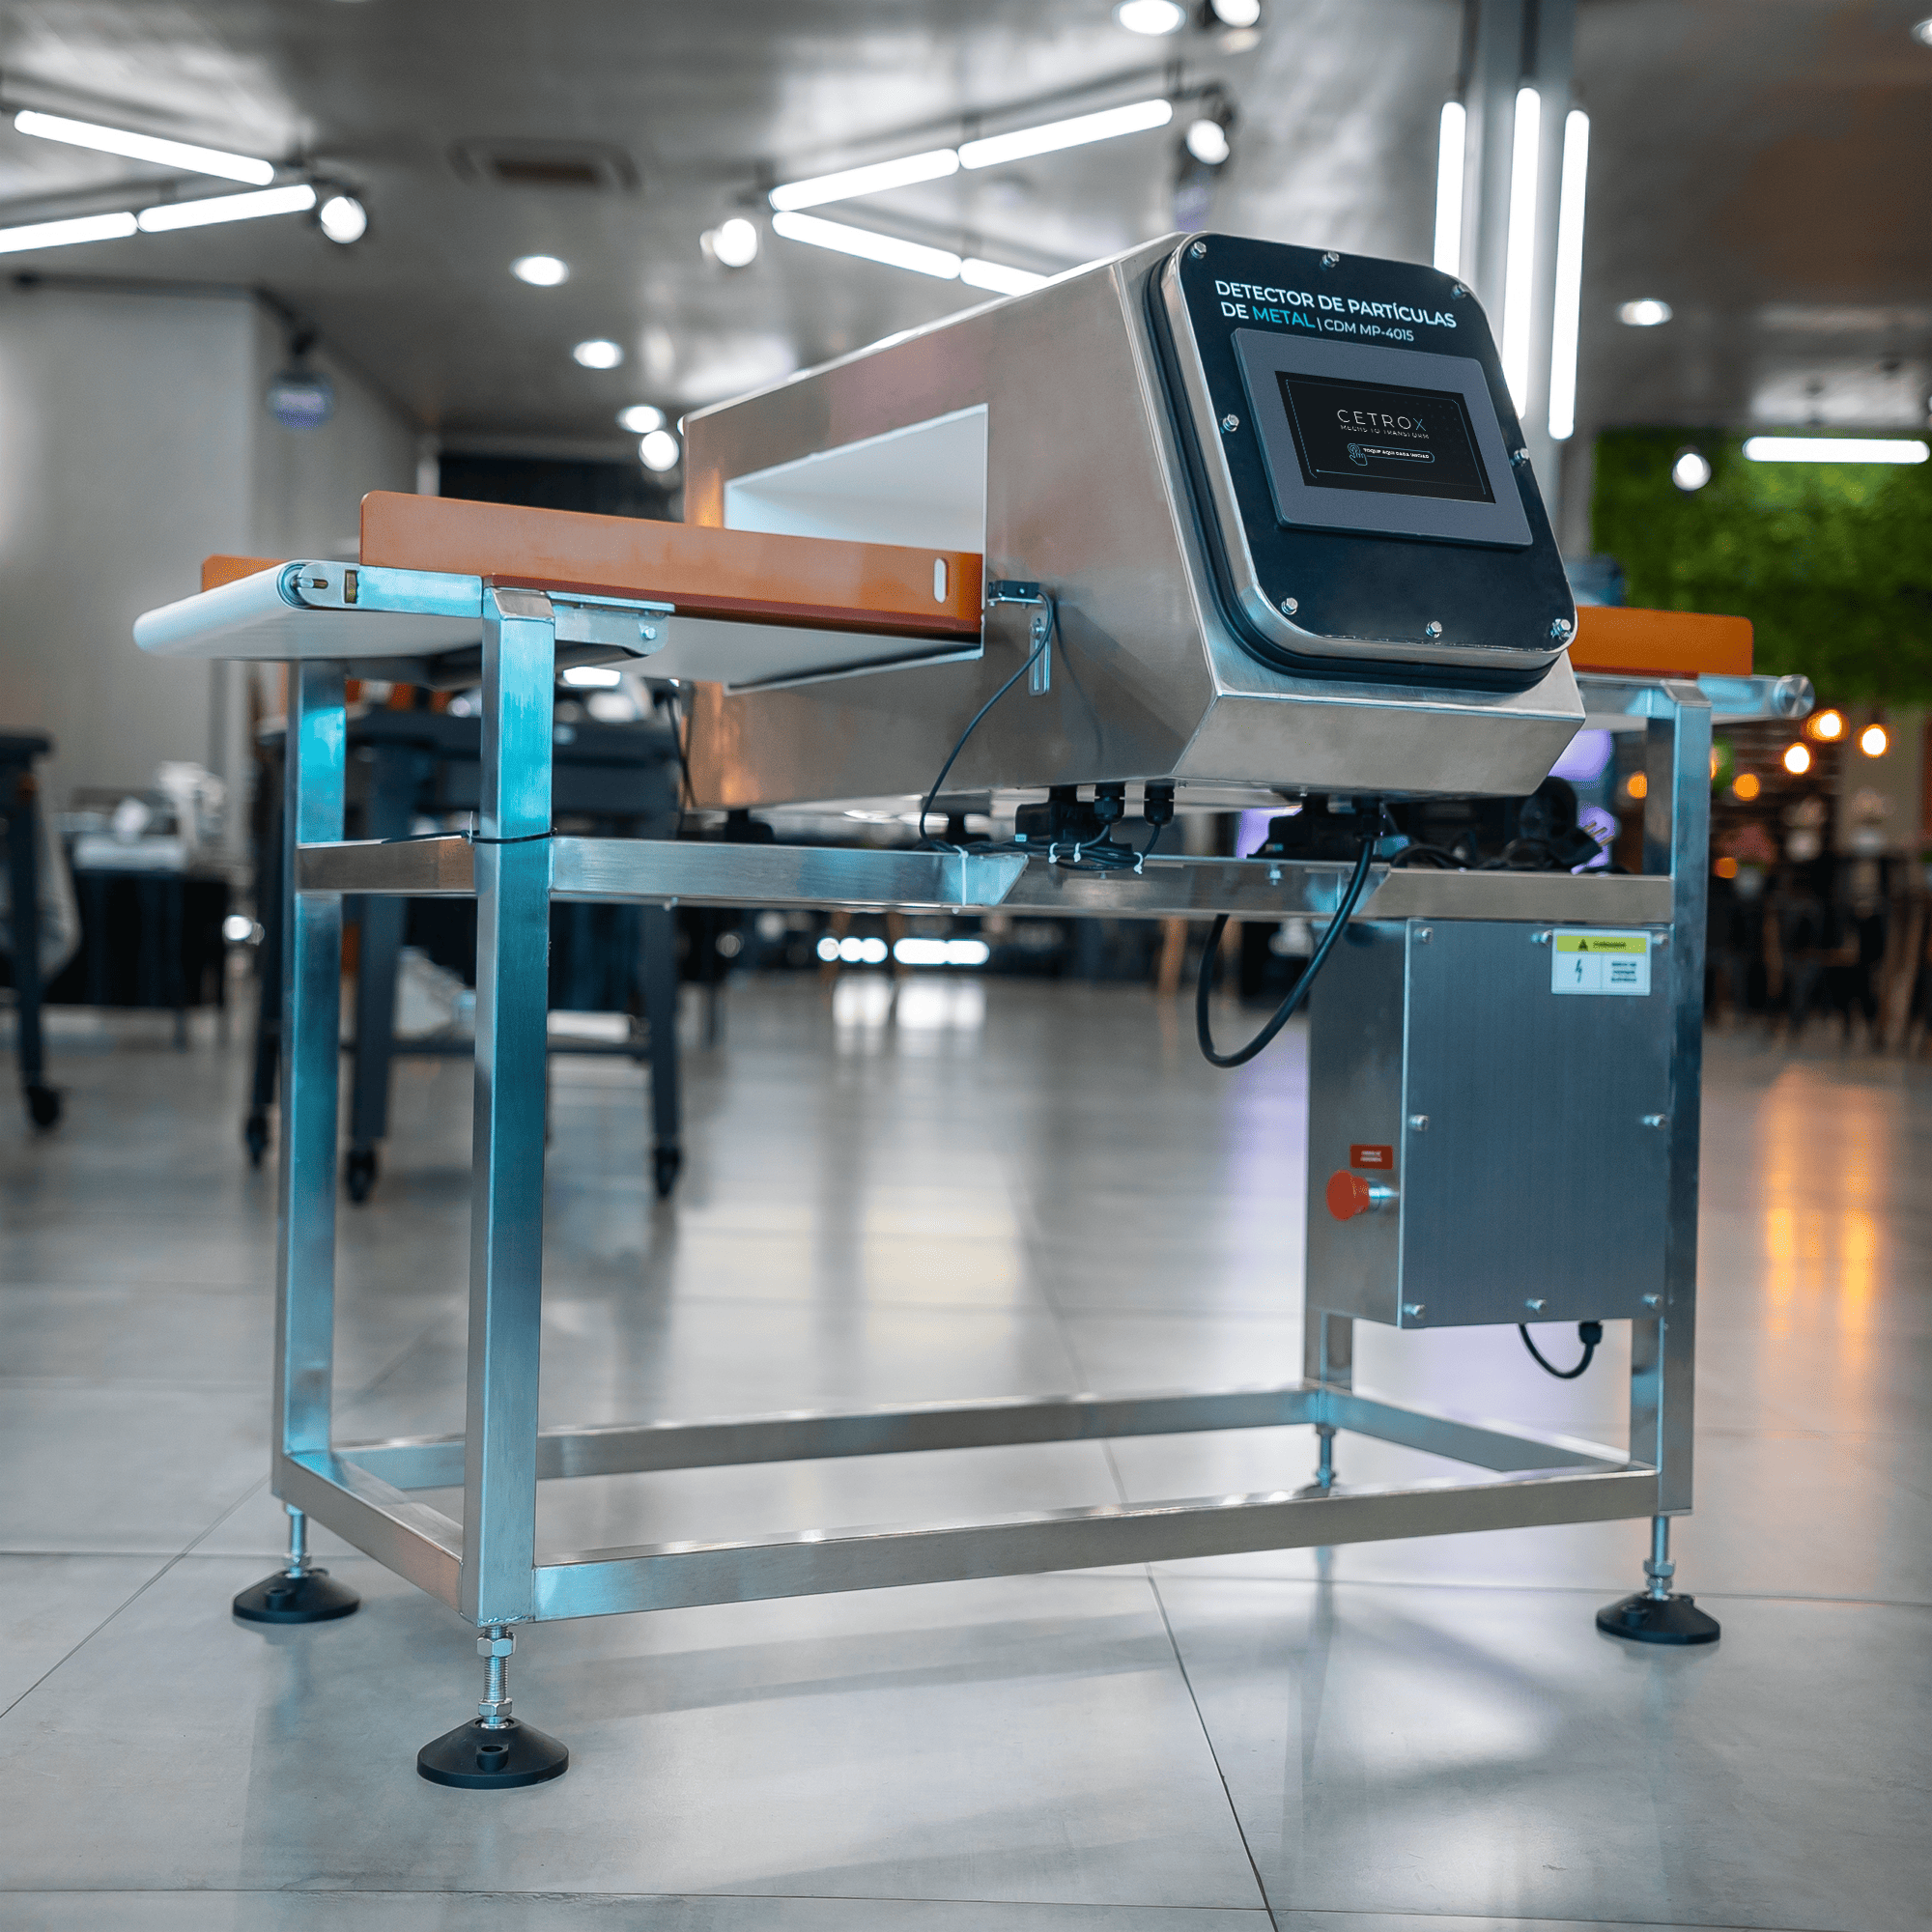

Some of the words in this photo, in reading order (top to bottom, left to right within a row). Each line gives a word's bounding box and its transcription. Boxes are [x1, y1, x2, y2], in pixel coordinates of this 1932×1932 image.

[1214, 279, 1316, 308] DETECTOR
[1317, 294, 1346, 313] DE
[1347, 298, 1457, 328] PARTÍCULAS
[1220, 300, 1250, 320] DE
[1252, 305, 1316, 328] METAL
[1323, 319, 1356, 334] CDM
[1359, 324, 1415, 342] MP-4015
[1337, 409, 1427, 432] CETROX
